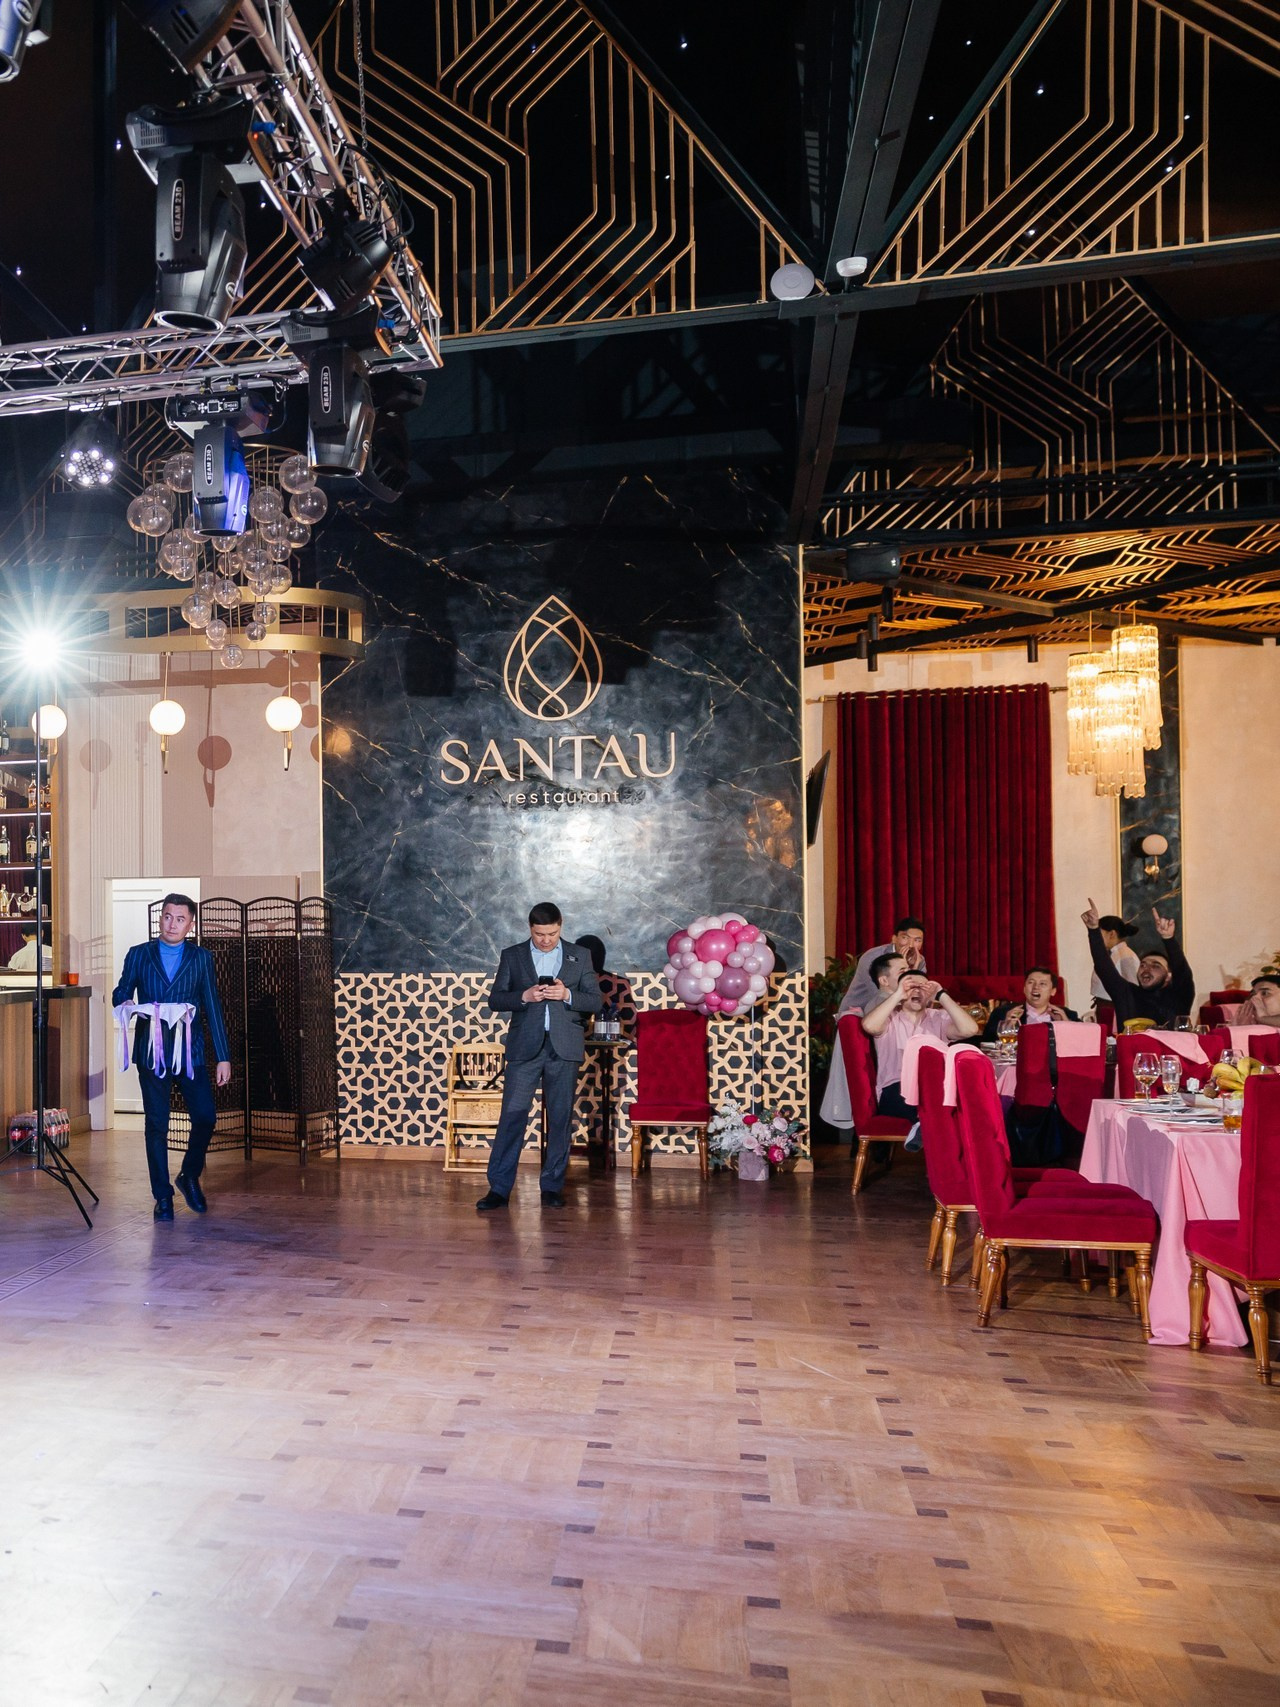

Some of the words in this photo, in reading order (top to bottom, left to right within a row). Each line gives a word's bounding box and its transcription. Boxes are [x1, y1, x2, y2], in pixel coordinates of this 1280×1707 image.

[175, 186, 183, 204] 230
[174, 205, 182, 233] BEAM
[440, 732, 676, 785] SANTAU
[508, 790, 619, 804] restaurant
